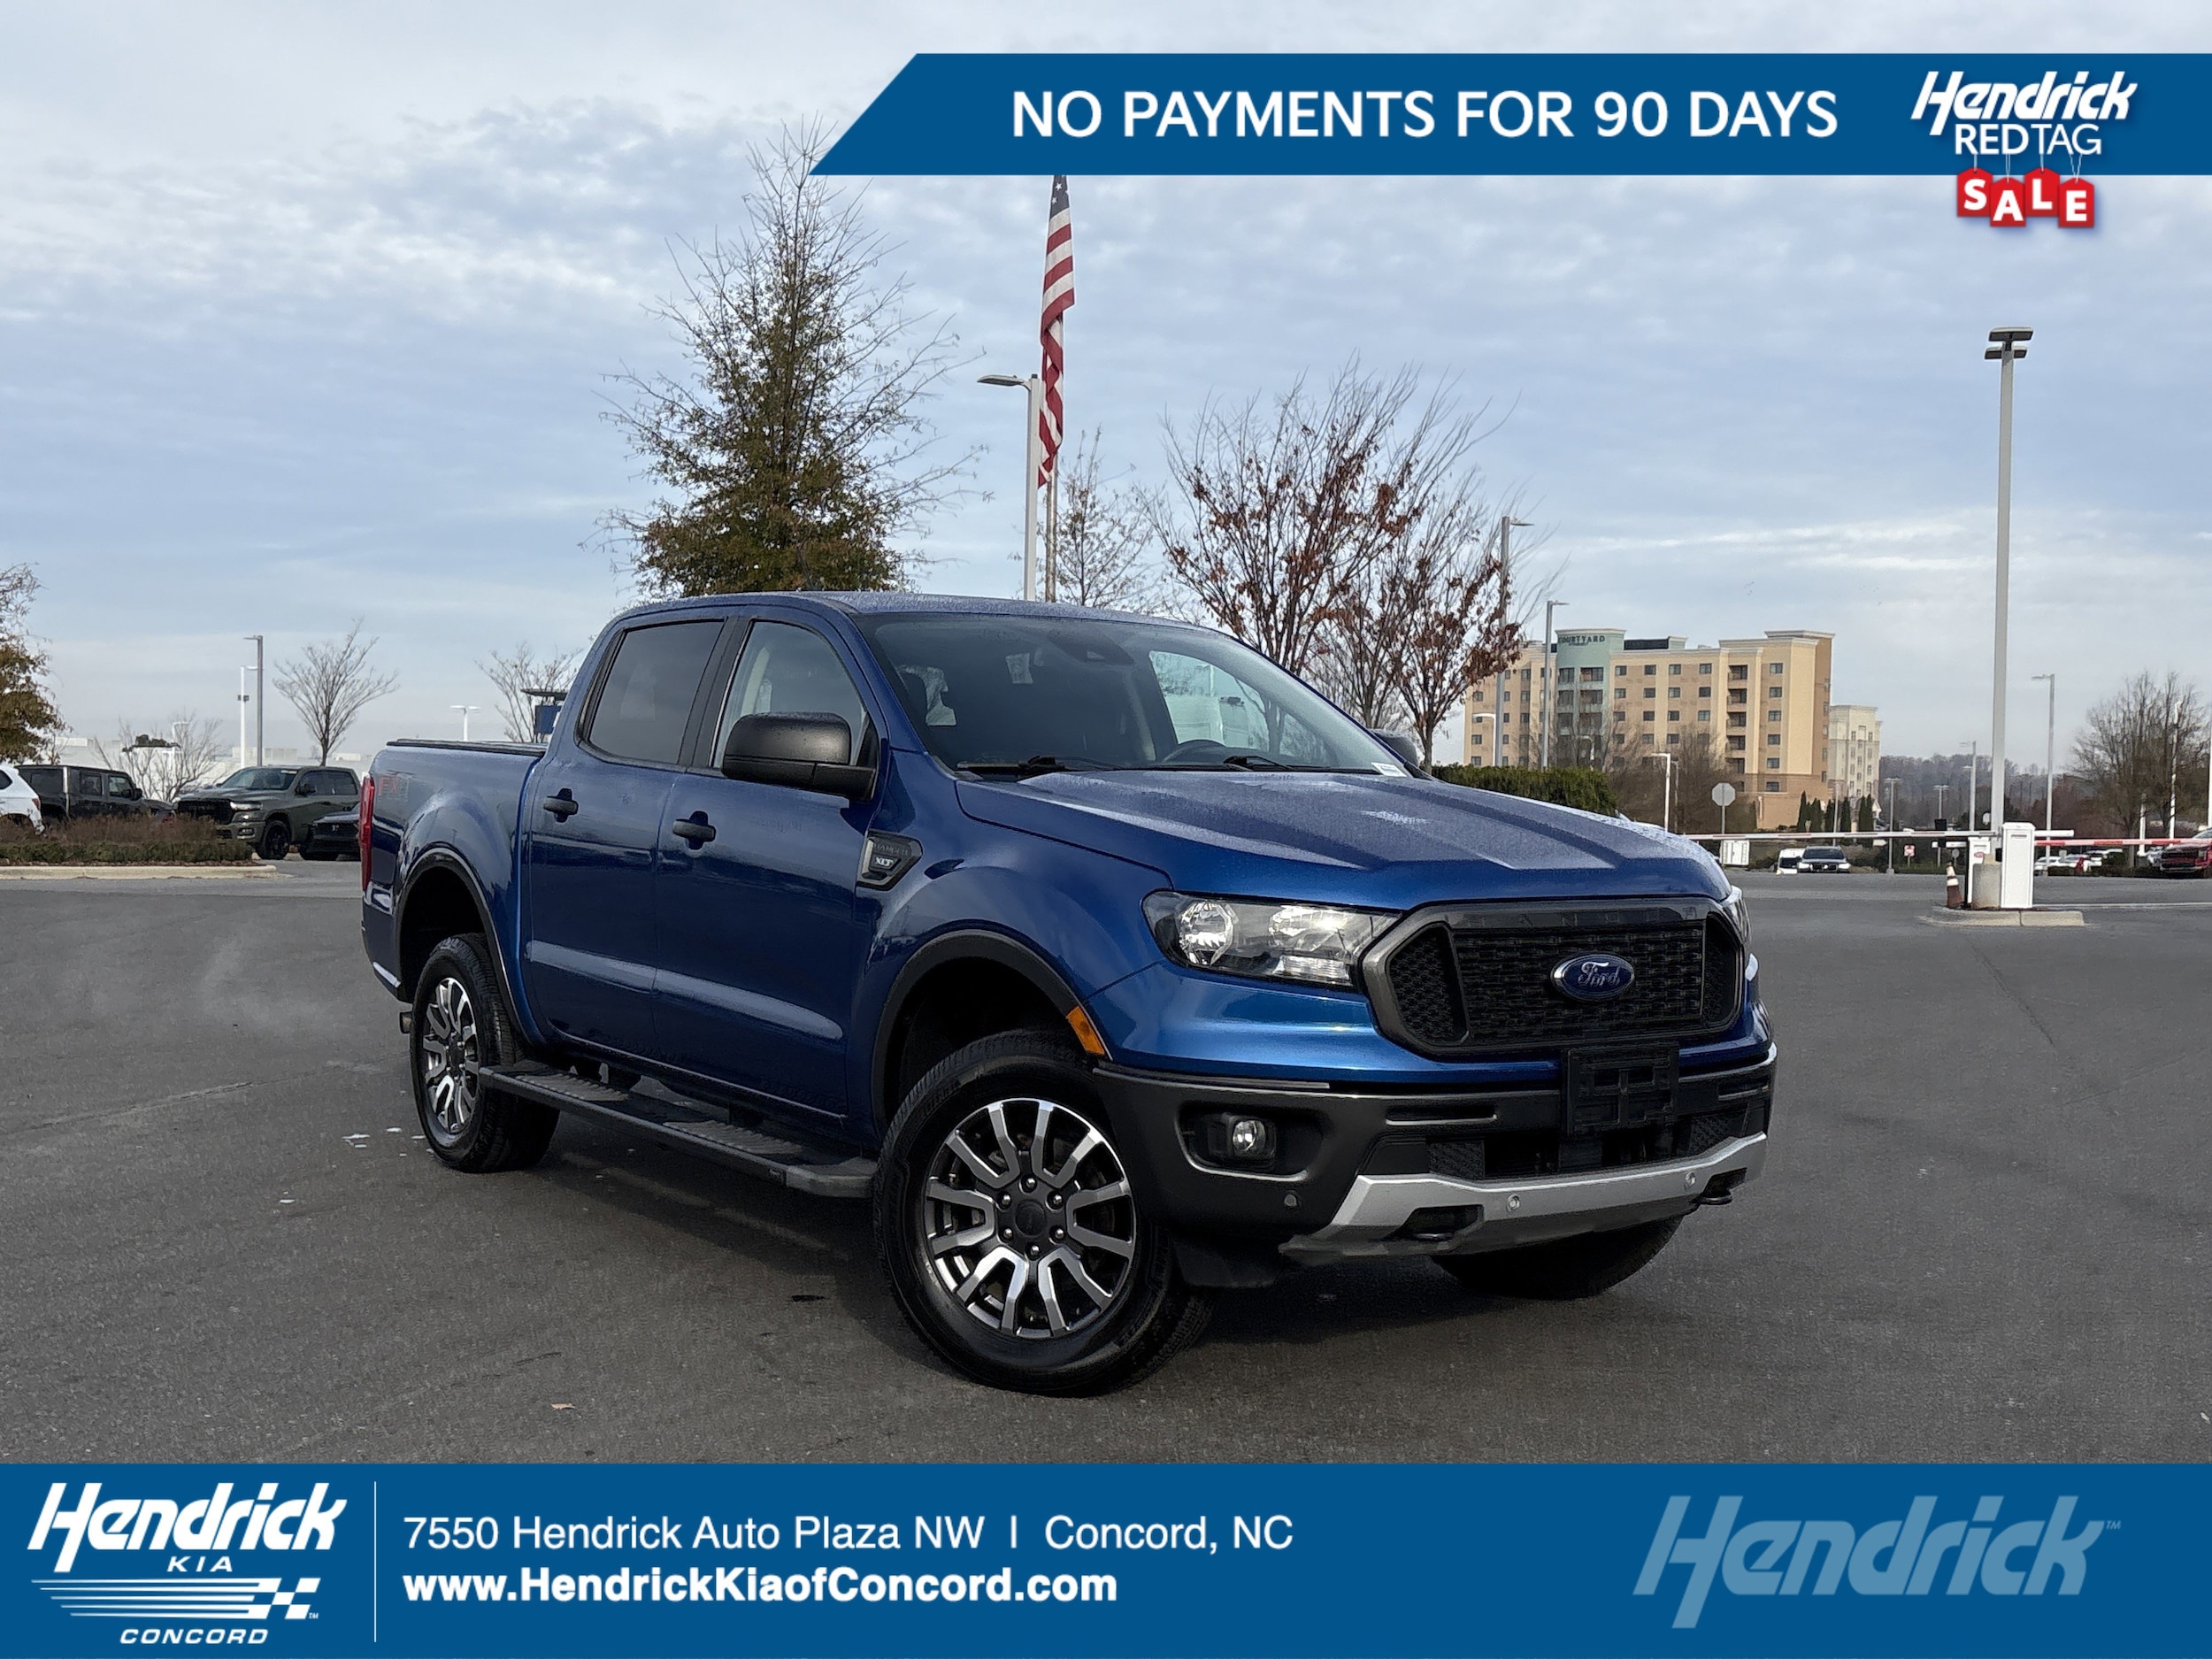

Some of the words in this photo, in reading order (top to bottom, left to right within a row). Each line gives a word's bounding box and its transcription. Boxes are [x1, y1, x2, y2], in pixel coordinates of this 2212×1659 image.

[1557, 634, 1606, 644] COURTYARD
[875, 856, 894, 867] XLT
[1577, 961, 1622, 987] Ford
